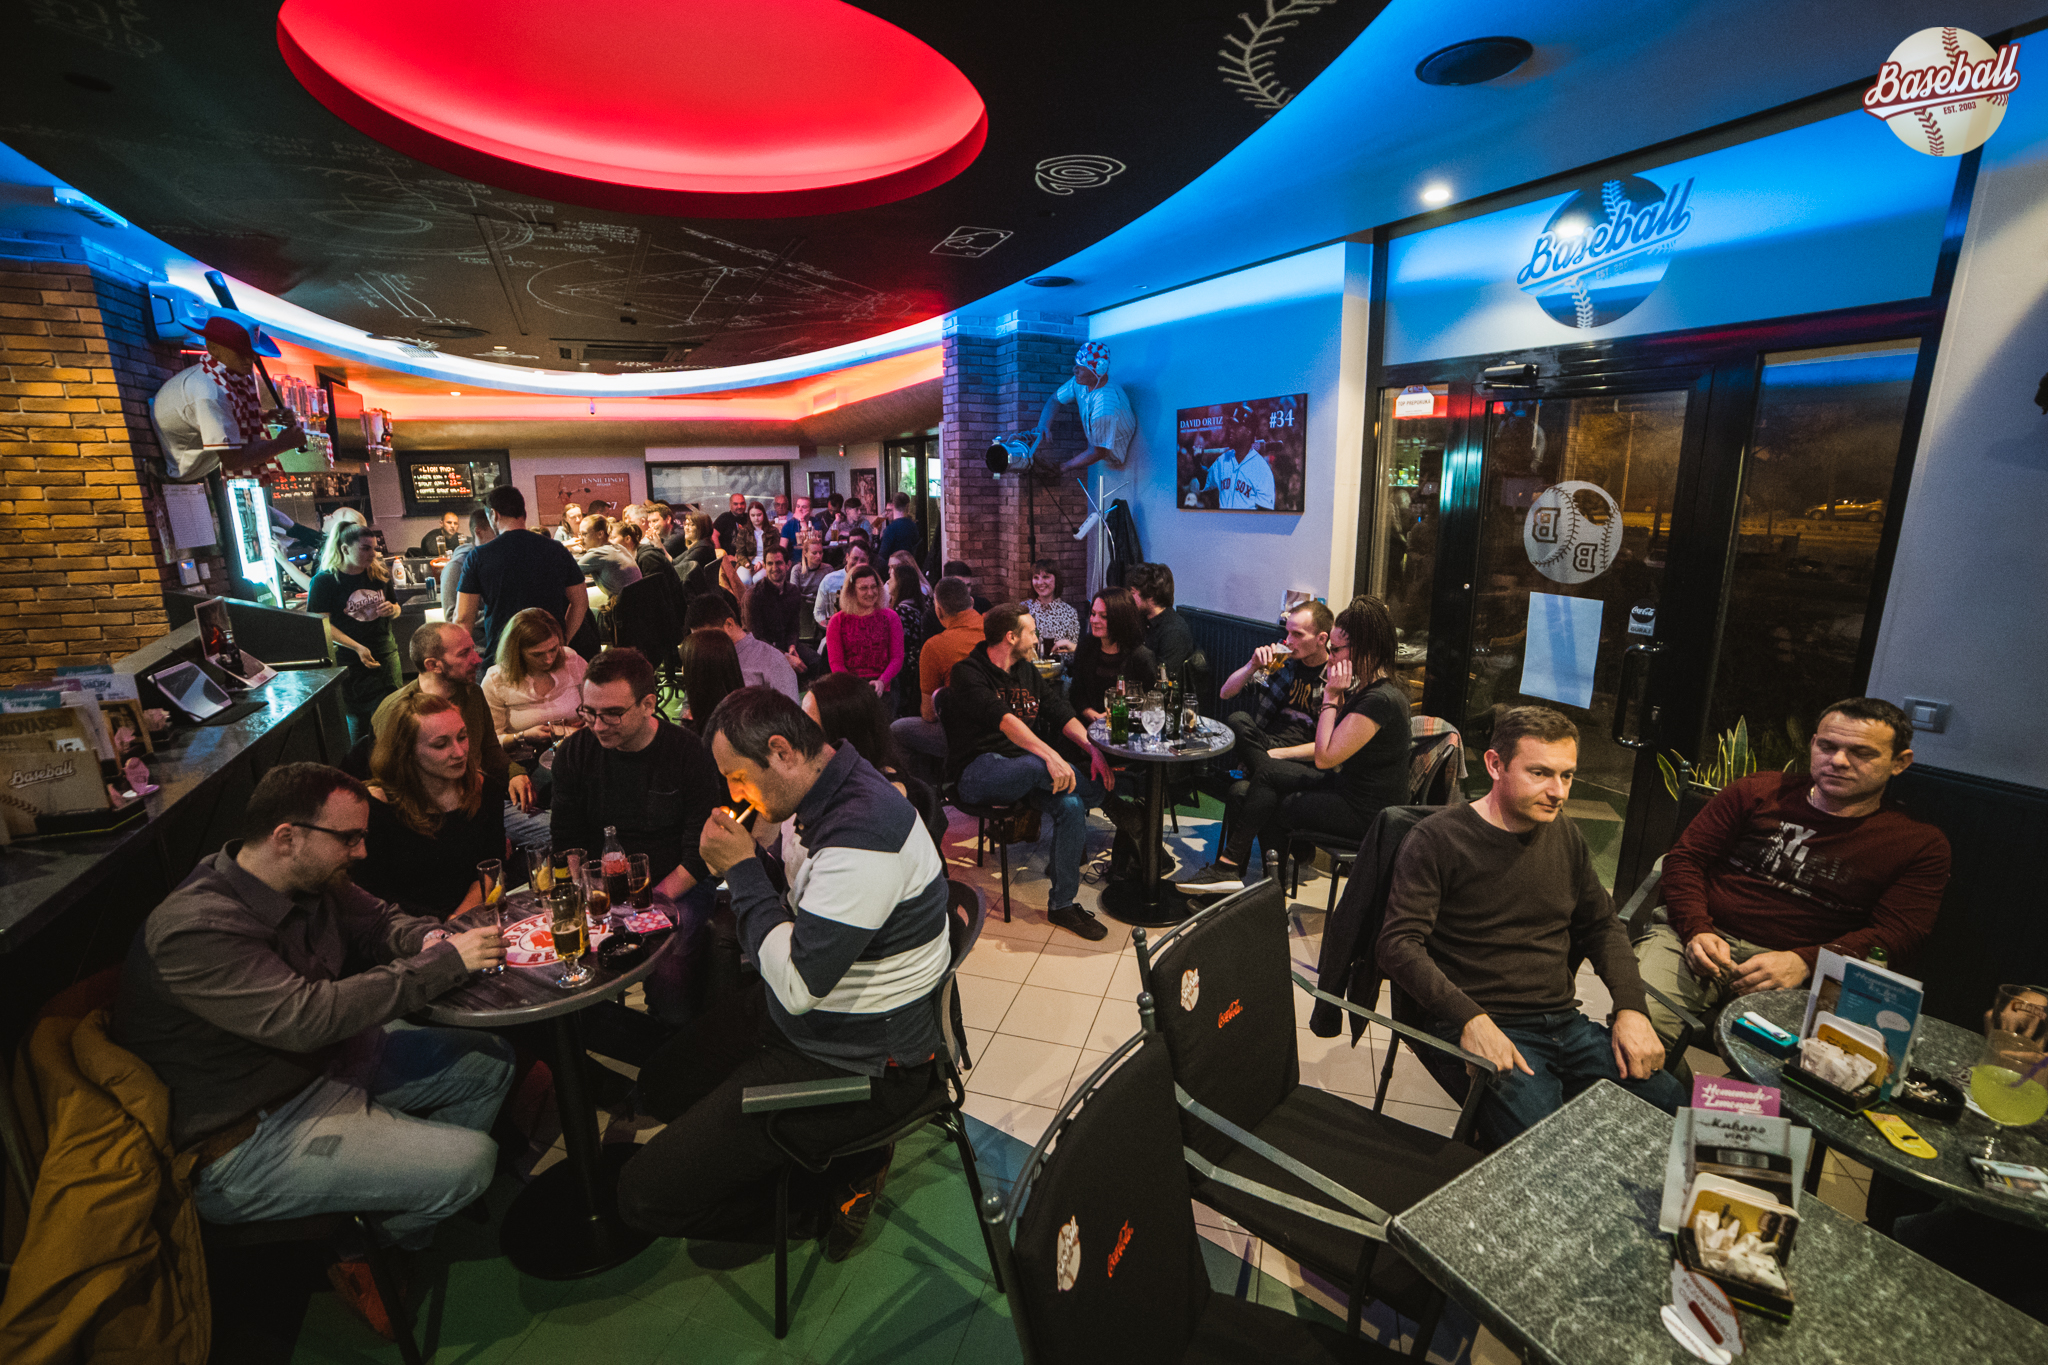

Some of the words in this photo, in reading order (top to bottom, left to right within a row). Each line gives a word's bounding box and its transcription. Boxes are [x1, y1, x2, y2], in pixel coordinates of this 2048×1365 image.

[1516, 175, 1696, 285] Baseball
[1180, 418, 1200, 429] DAVID
[1202, 416, 1223, 426] ORTIZ
[1269, 408, 1295, 429] #34
[1235, 480, 1252, 498] SOX
[9, 760, 75, 786] Baseball
